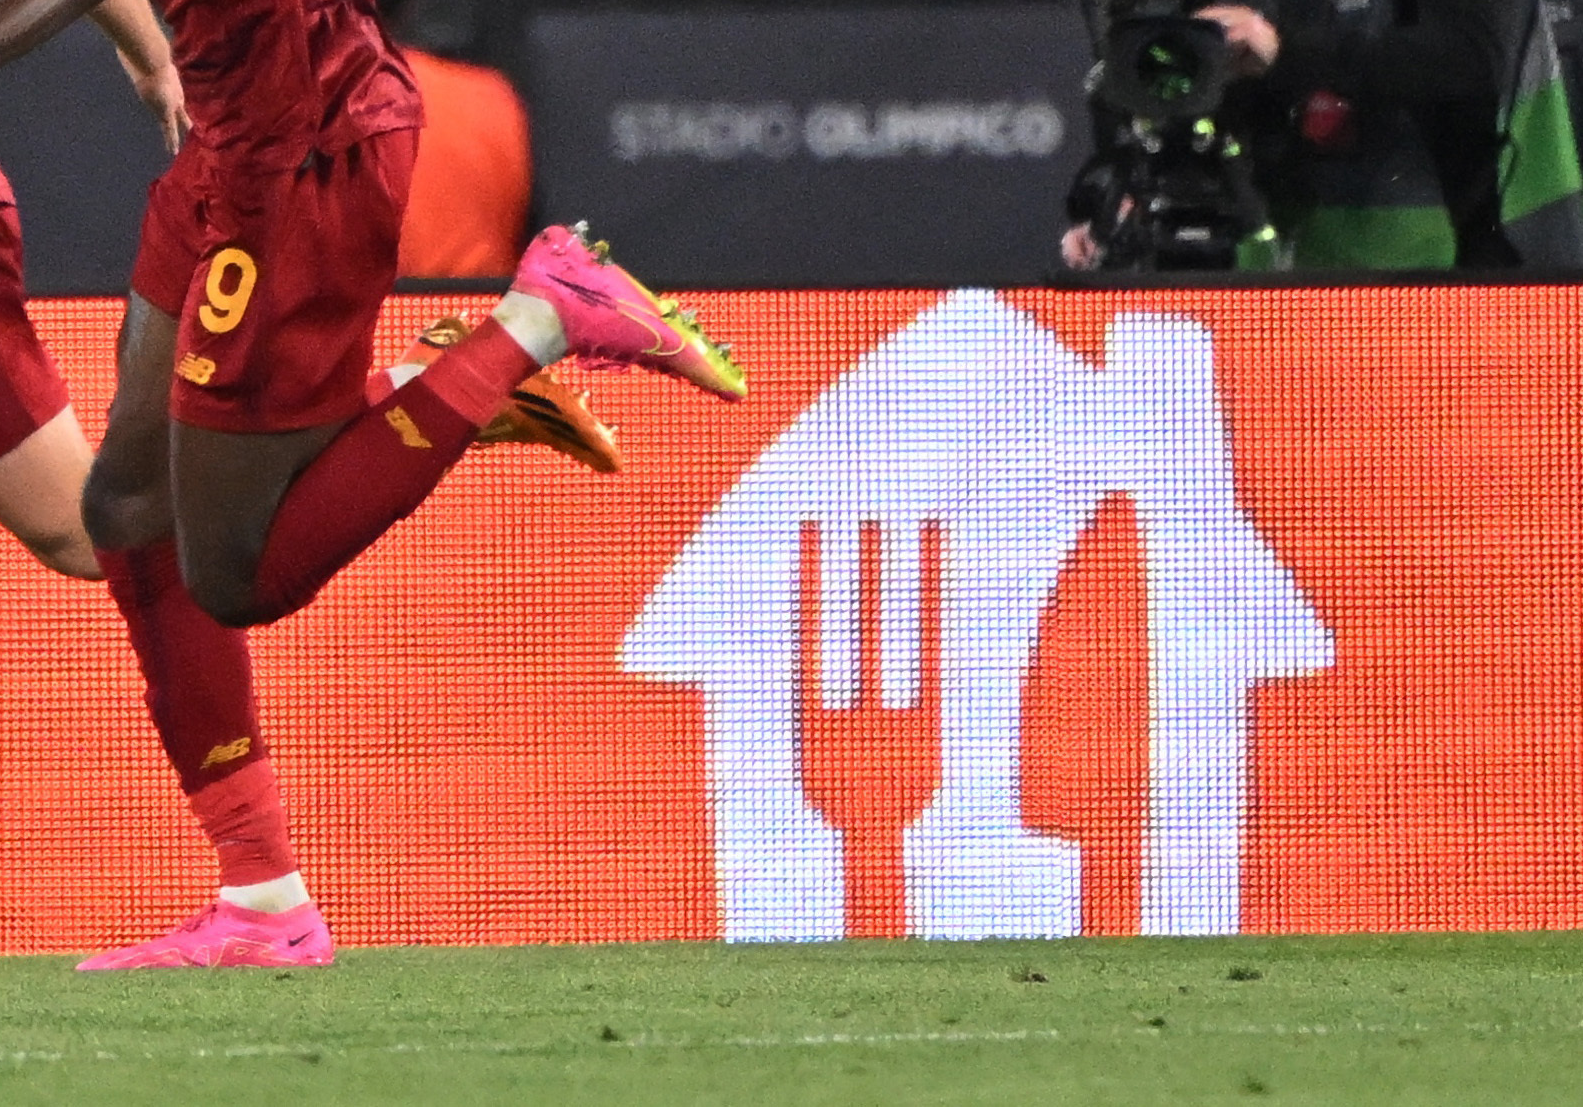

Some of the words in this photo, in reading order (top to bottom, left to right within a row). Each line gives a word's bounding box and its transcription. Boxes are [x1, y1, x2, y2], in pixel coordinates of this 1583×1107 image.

[612, 101, 798, 163] STADIO
[804, 101, 1065, 159] OLIMPICO
[199, 248, 257, 333] 9
